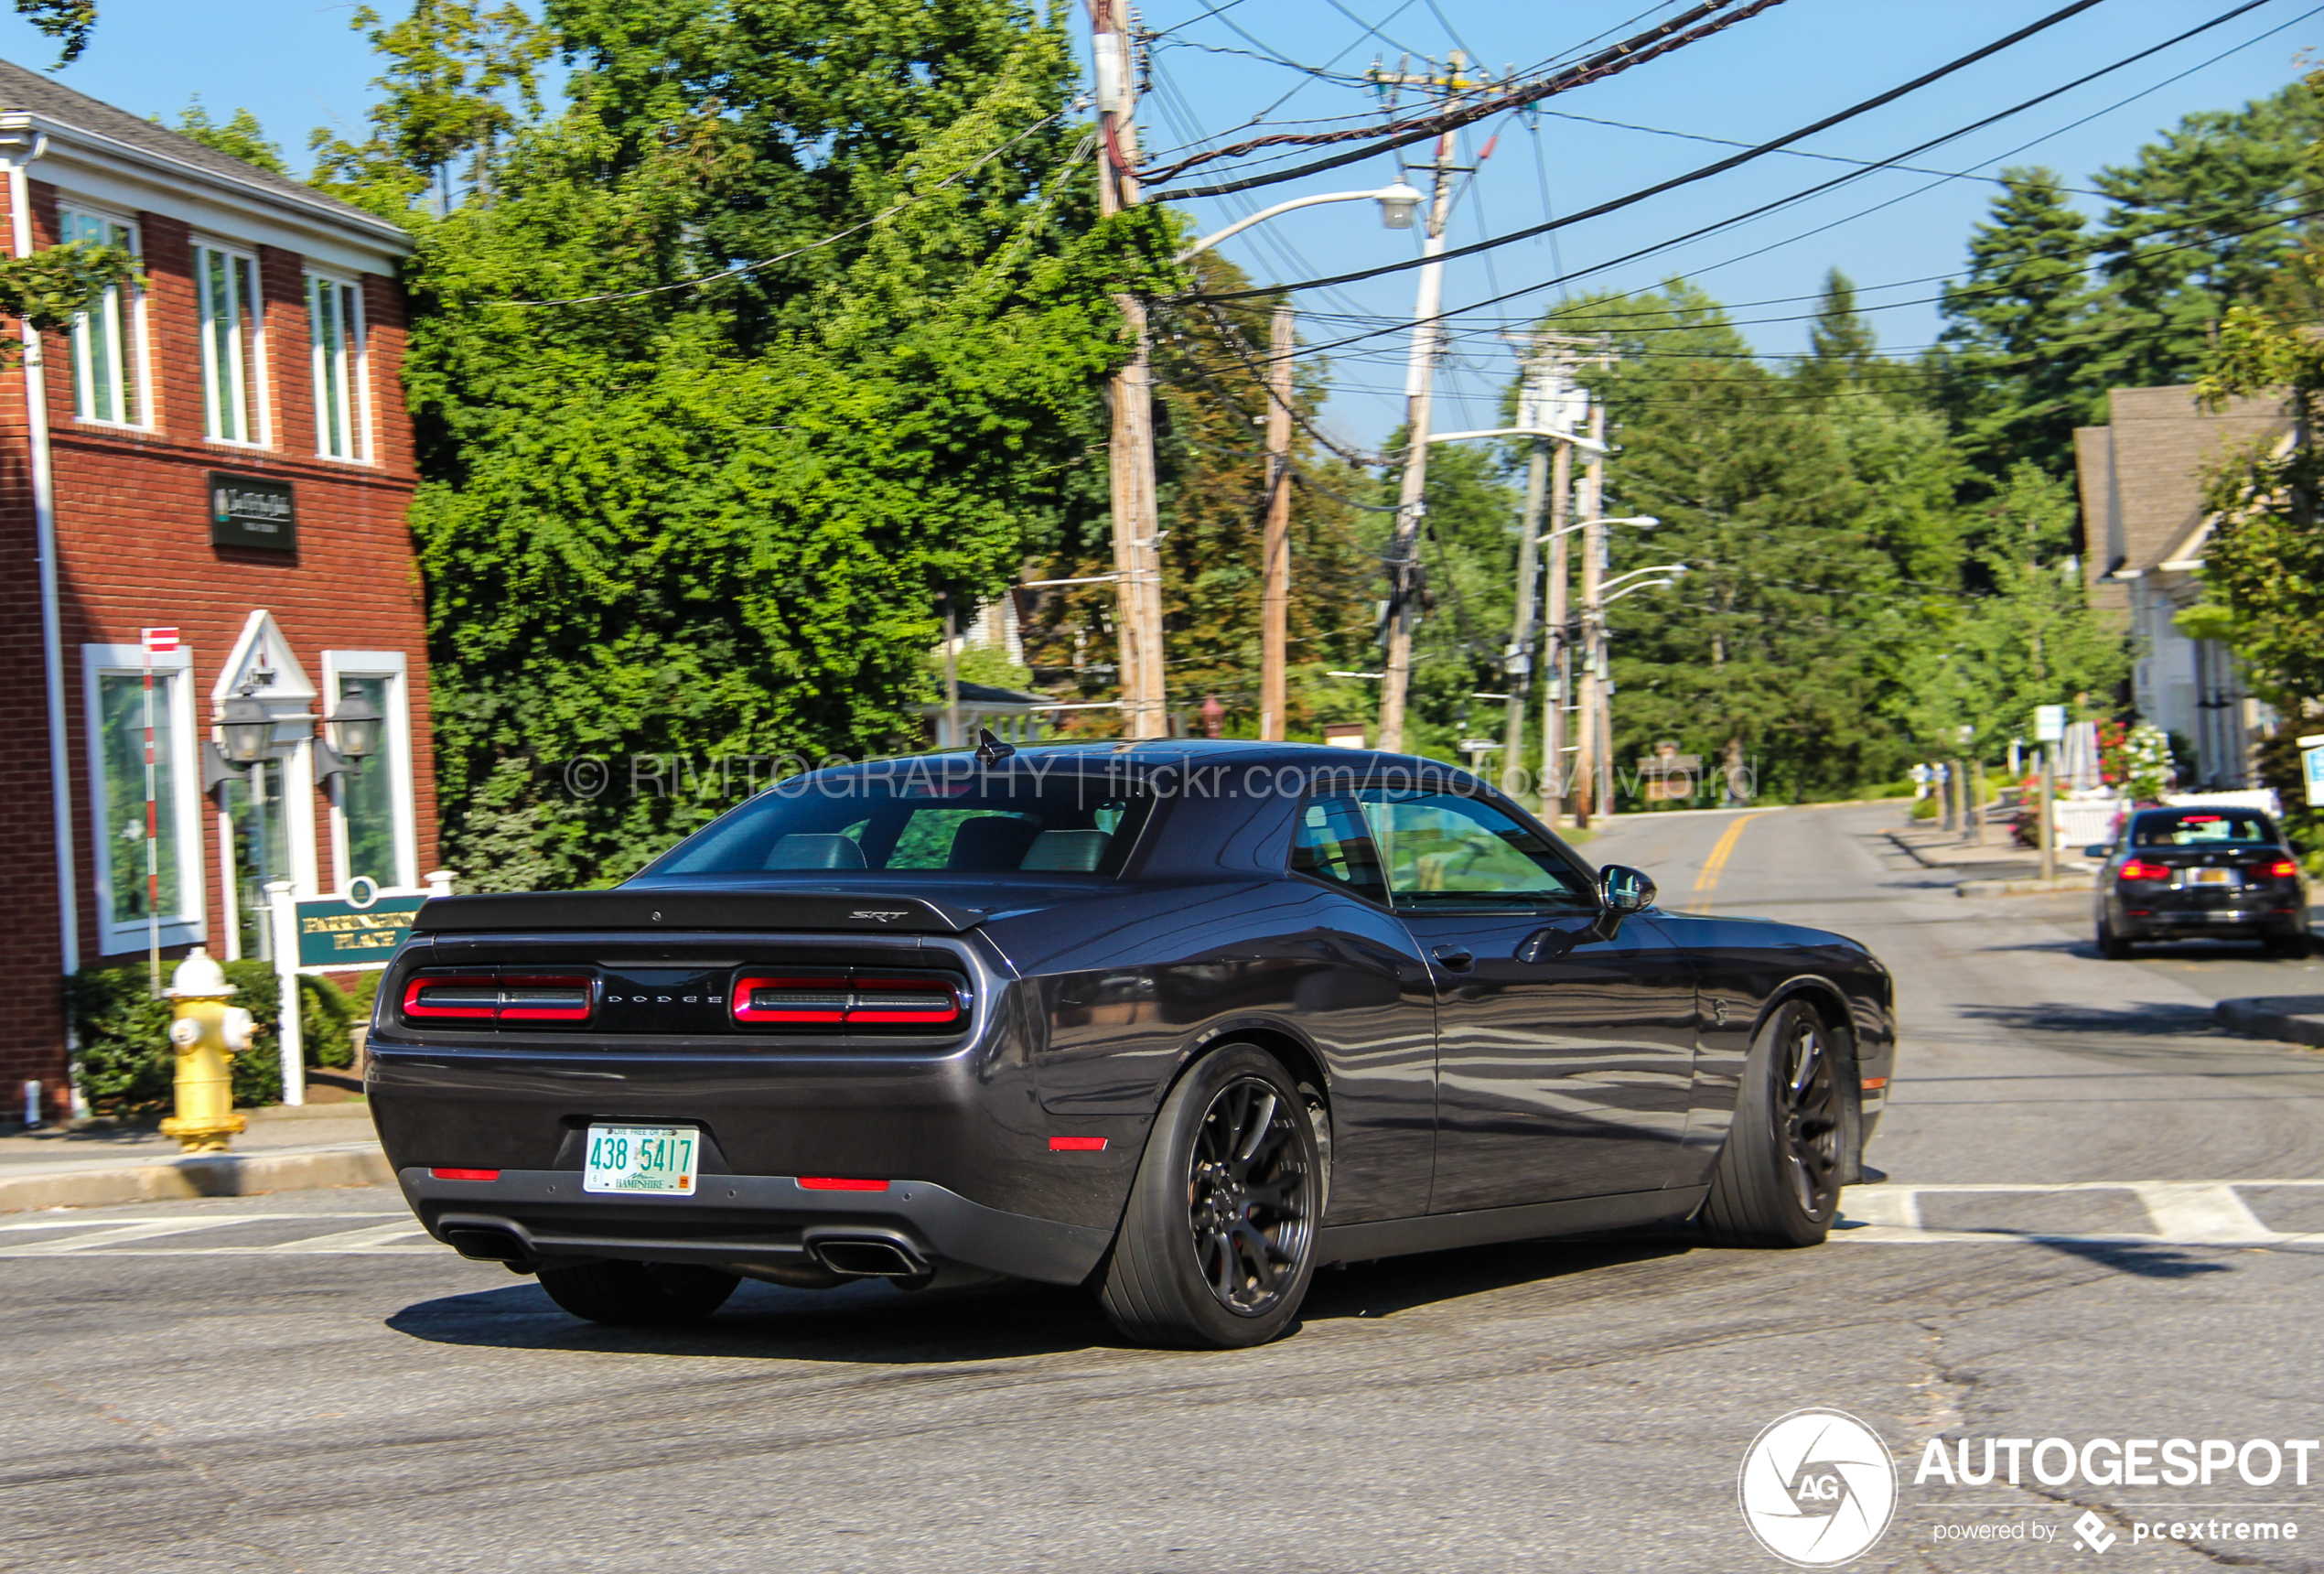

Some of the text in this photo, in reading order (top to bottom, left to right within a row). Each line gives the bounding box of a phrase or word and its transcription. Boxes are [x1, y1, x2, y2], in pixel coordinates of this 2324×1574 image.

[848, 911, 909, 922] SRT
[608, 996, 723, 1004] DODGE
[590, 1137, 692, 1172] 438 5417
[616, 1178, 664, 1190] HAMPSHIRE
